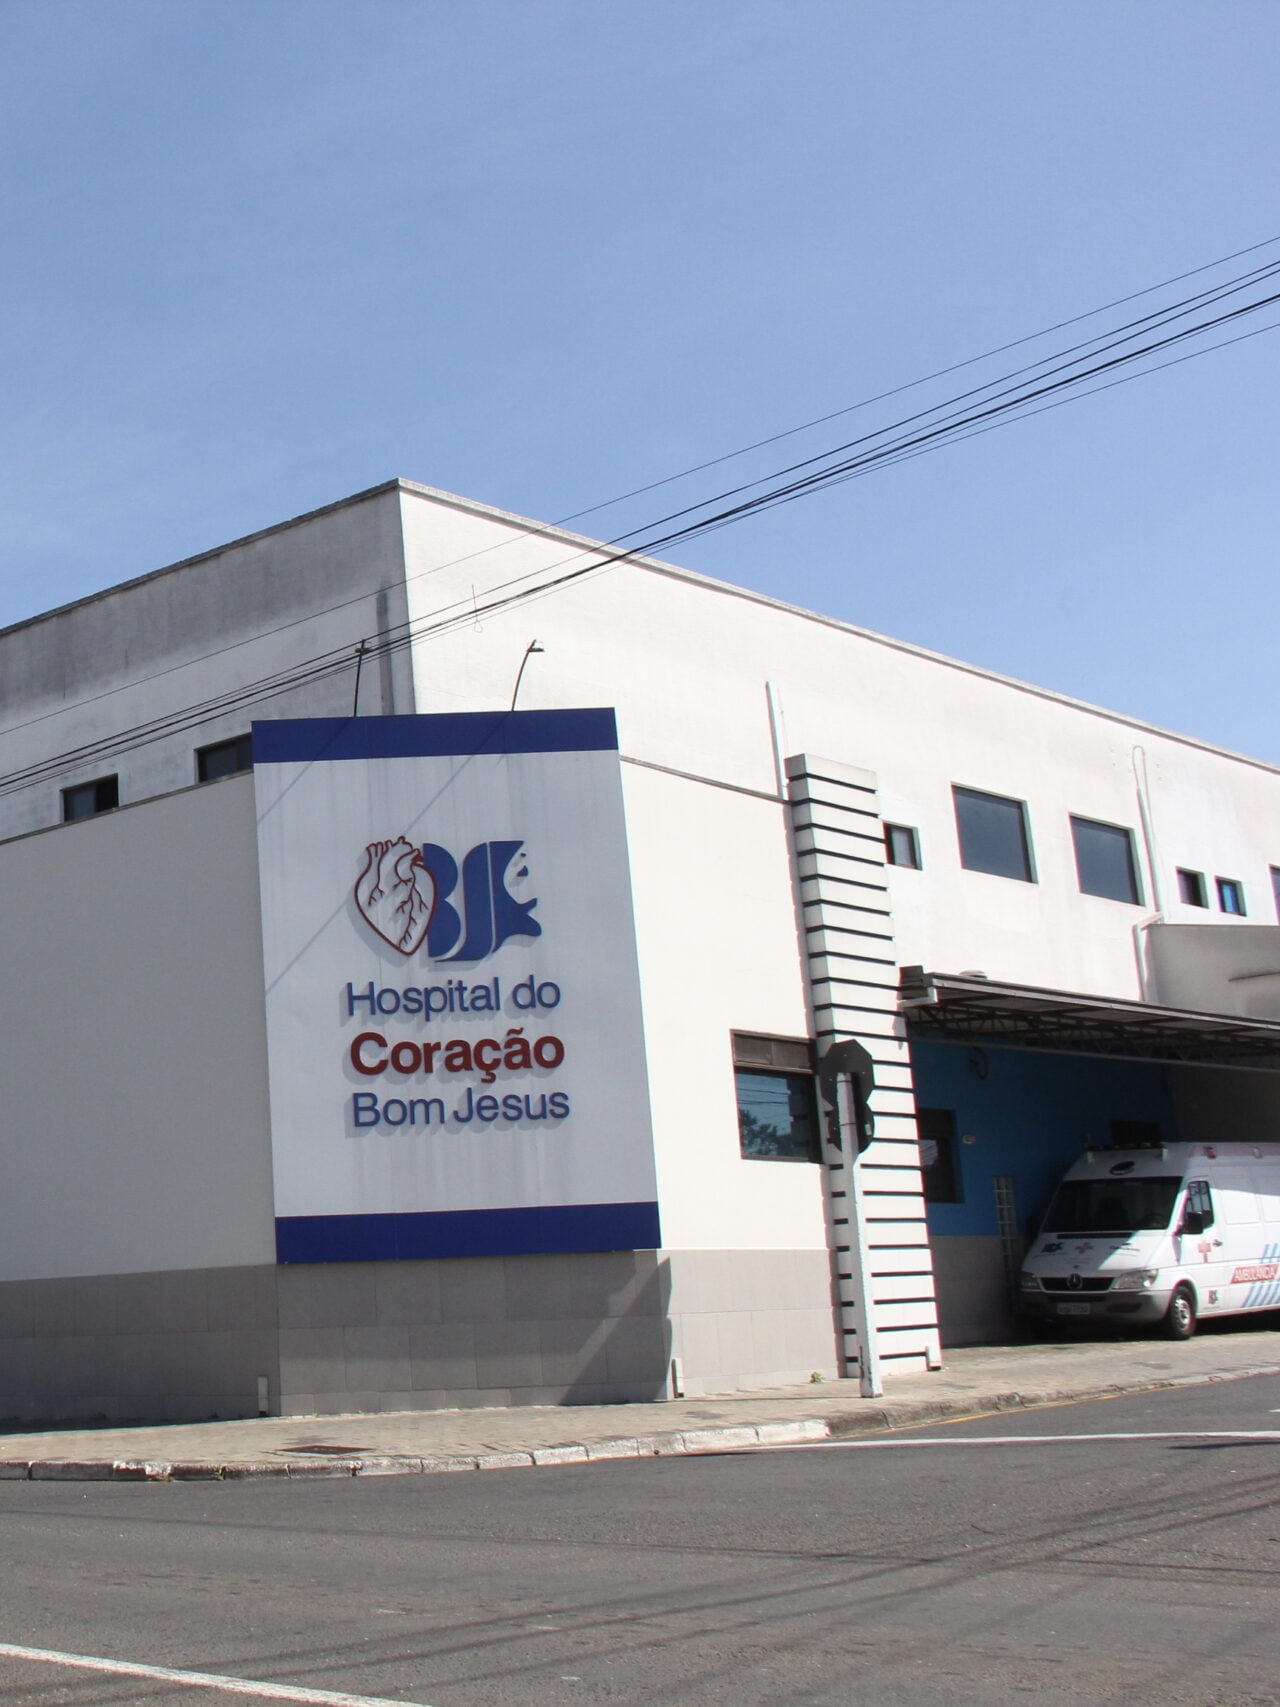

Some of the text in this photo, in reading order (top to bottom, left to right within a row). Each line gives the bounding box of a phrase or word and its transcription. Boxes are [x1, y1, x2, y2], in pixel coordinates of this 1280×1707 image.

[347, 974, 561, 1021] Hospital do
[350, 1027, 565, 1083] Coração
[353, 1087, 570, 1127] Bom Jesus
